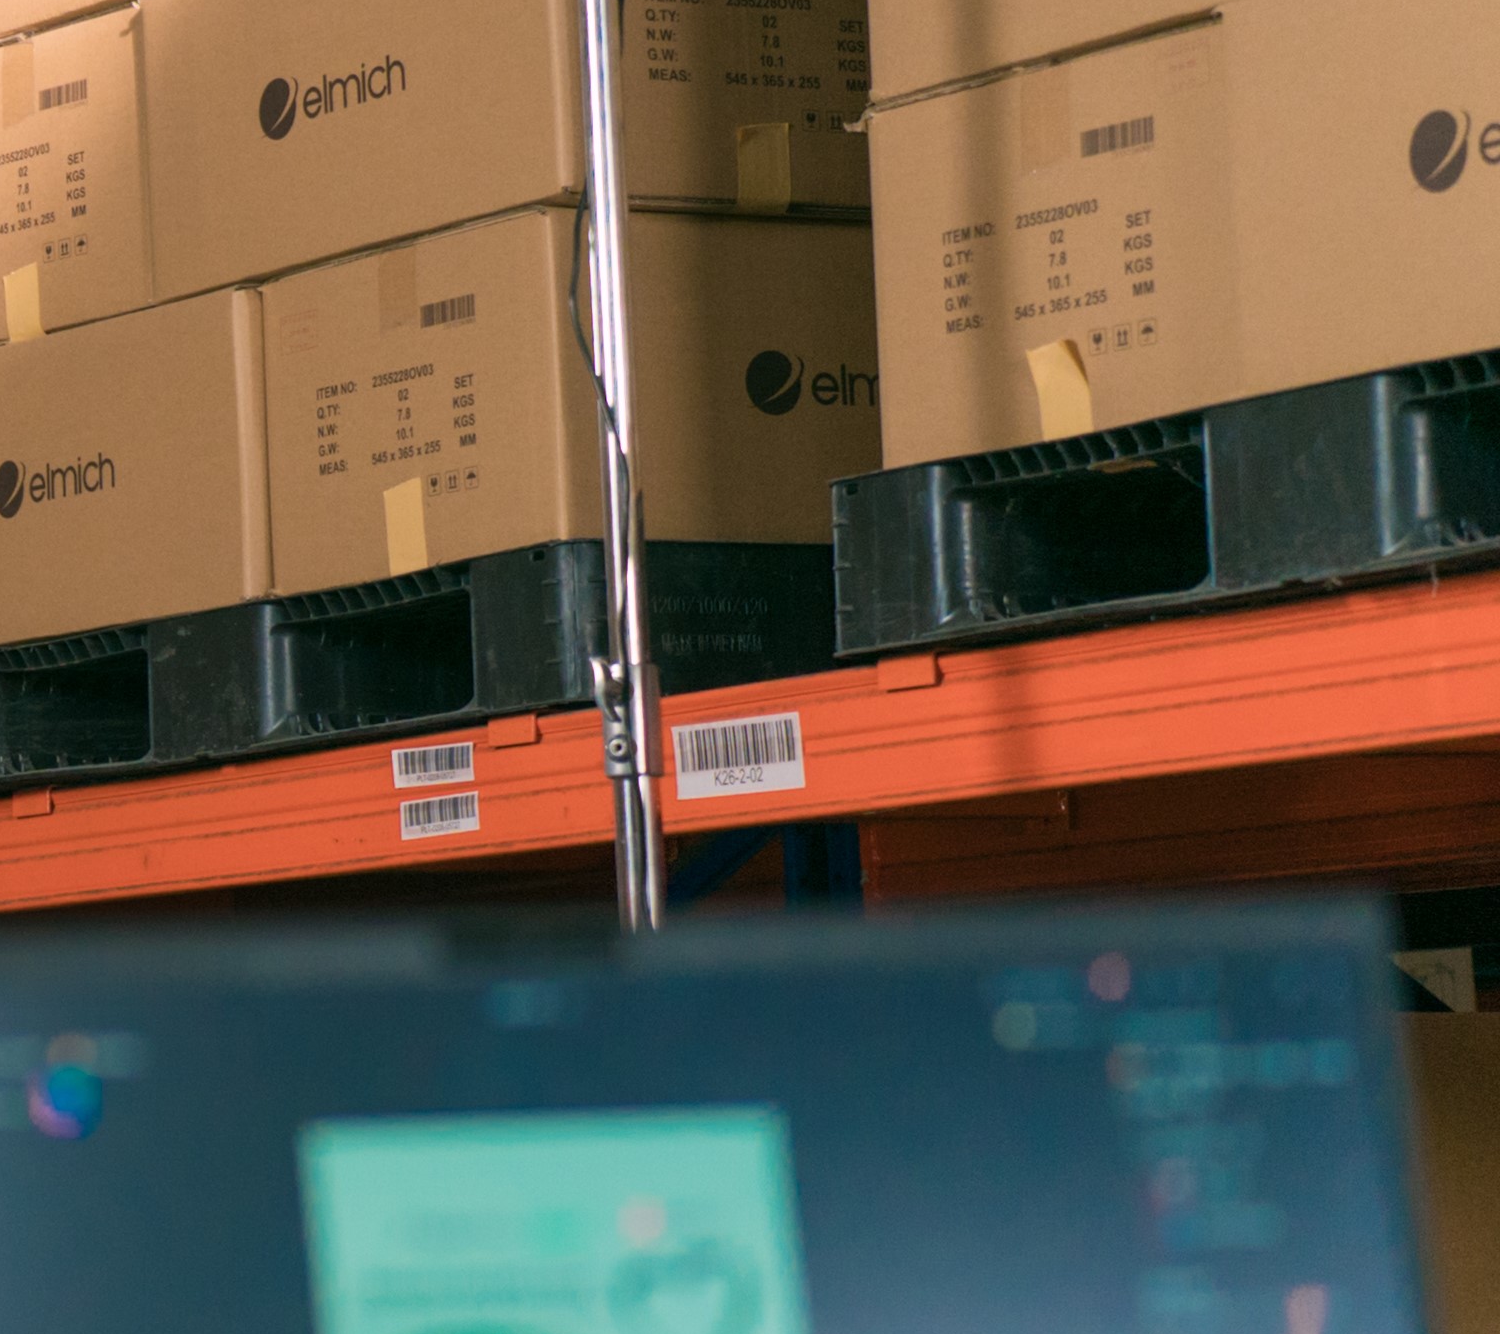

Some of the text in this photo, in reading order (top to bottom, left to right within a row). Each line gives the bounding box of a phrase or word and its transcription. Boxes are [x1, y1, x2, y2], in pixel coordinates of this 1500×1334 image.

[303, 55, 406, 119] elmich
[942, 225, 971, 246] ITEM
[973, 222, 996, 239] NO:
[943, 210, 1152, 268] Q.TY: 02 SET
[944, 234, 1152, 290] N.W: 7.8 KGS
[945, 257, 1153, 312] G.W: 10.1 KGS
[946, 315, 983, 334] MEAS:
[1015, 305, 1036, 321] 545
[1049, 296, 1071, 313] 365
[1085, 289, 1107, 306] 255
[1132, 280, 1155, 297] MM
[29, 453, 115, 503] elmich
[714, 767, 764, 787] K26-2-02
